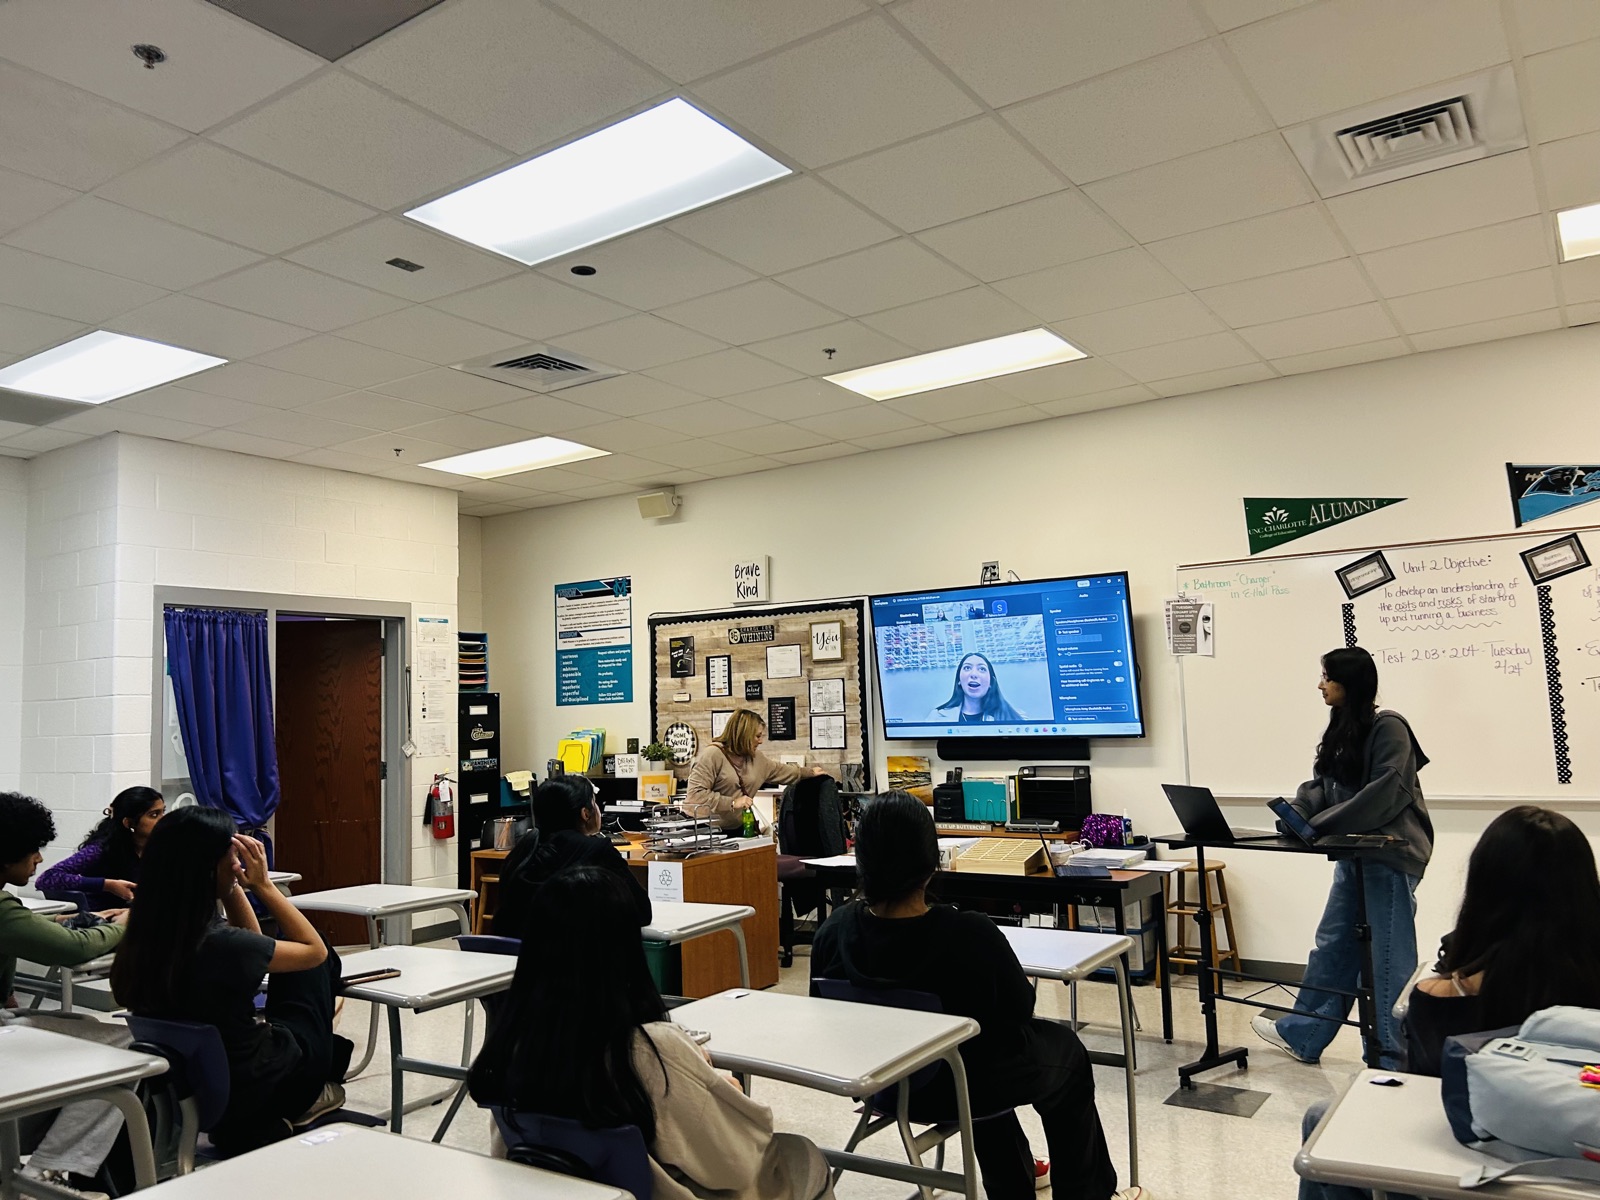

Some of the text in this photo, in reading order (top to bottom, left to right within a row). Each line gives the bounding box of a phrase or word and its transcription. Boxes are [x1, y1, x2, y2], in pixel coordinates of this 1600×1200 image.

[1309, 500, 1378, 526] ALUMNI
[1248, 520, 1307, 536] UNC CHARLOTTE
[734, 562, 760, 579] Brave
[1402, 560, 1426, 574] Unit
[1430, 560, 1442, 571] 2
[736, 578, 758, 600] Kind
[1193, 579, 1232, 590] Bathroom
[1378, 584, 1393, 598] To
[1395, 586, 1426, 598] develop
[1441, 580, 1504, 596] understanding
[1508, 578, 1520, 588] of
[1378, 602, 1393, 611] the
[1418, 598, 1436, 608] and
[1438, 596, 1463, 607] risks
[1467, 594, 1478, 604] of
[1478, 593, 1516, 608] starting
[1379, 614, 1390, 626] up
[1392, 612, 1408, 622] and
[1410, 612, 1444, 625] running
[1457, 607, 1498, 618] business
[740, 631, 772, 643] WHINING
[812, 632, 840, 650] You
[1377, 648, 1406, 664] Test
[1484, 640, 1532, 666] Tuesday
